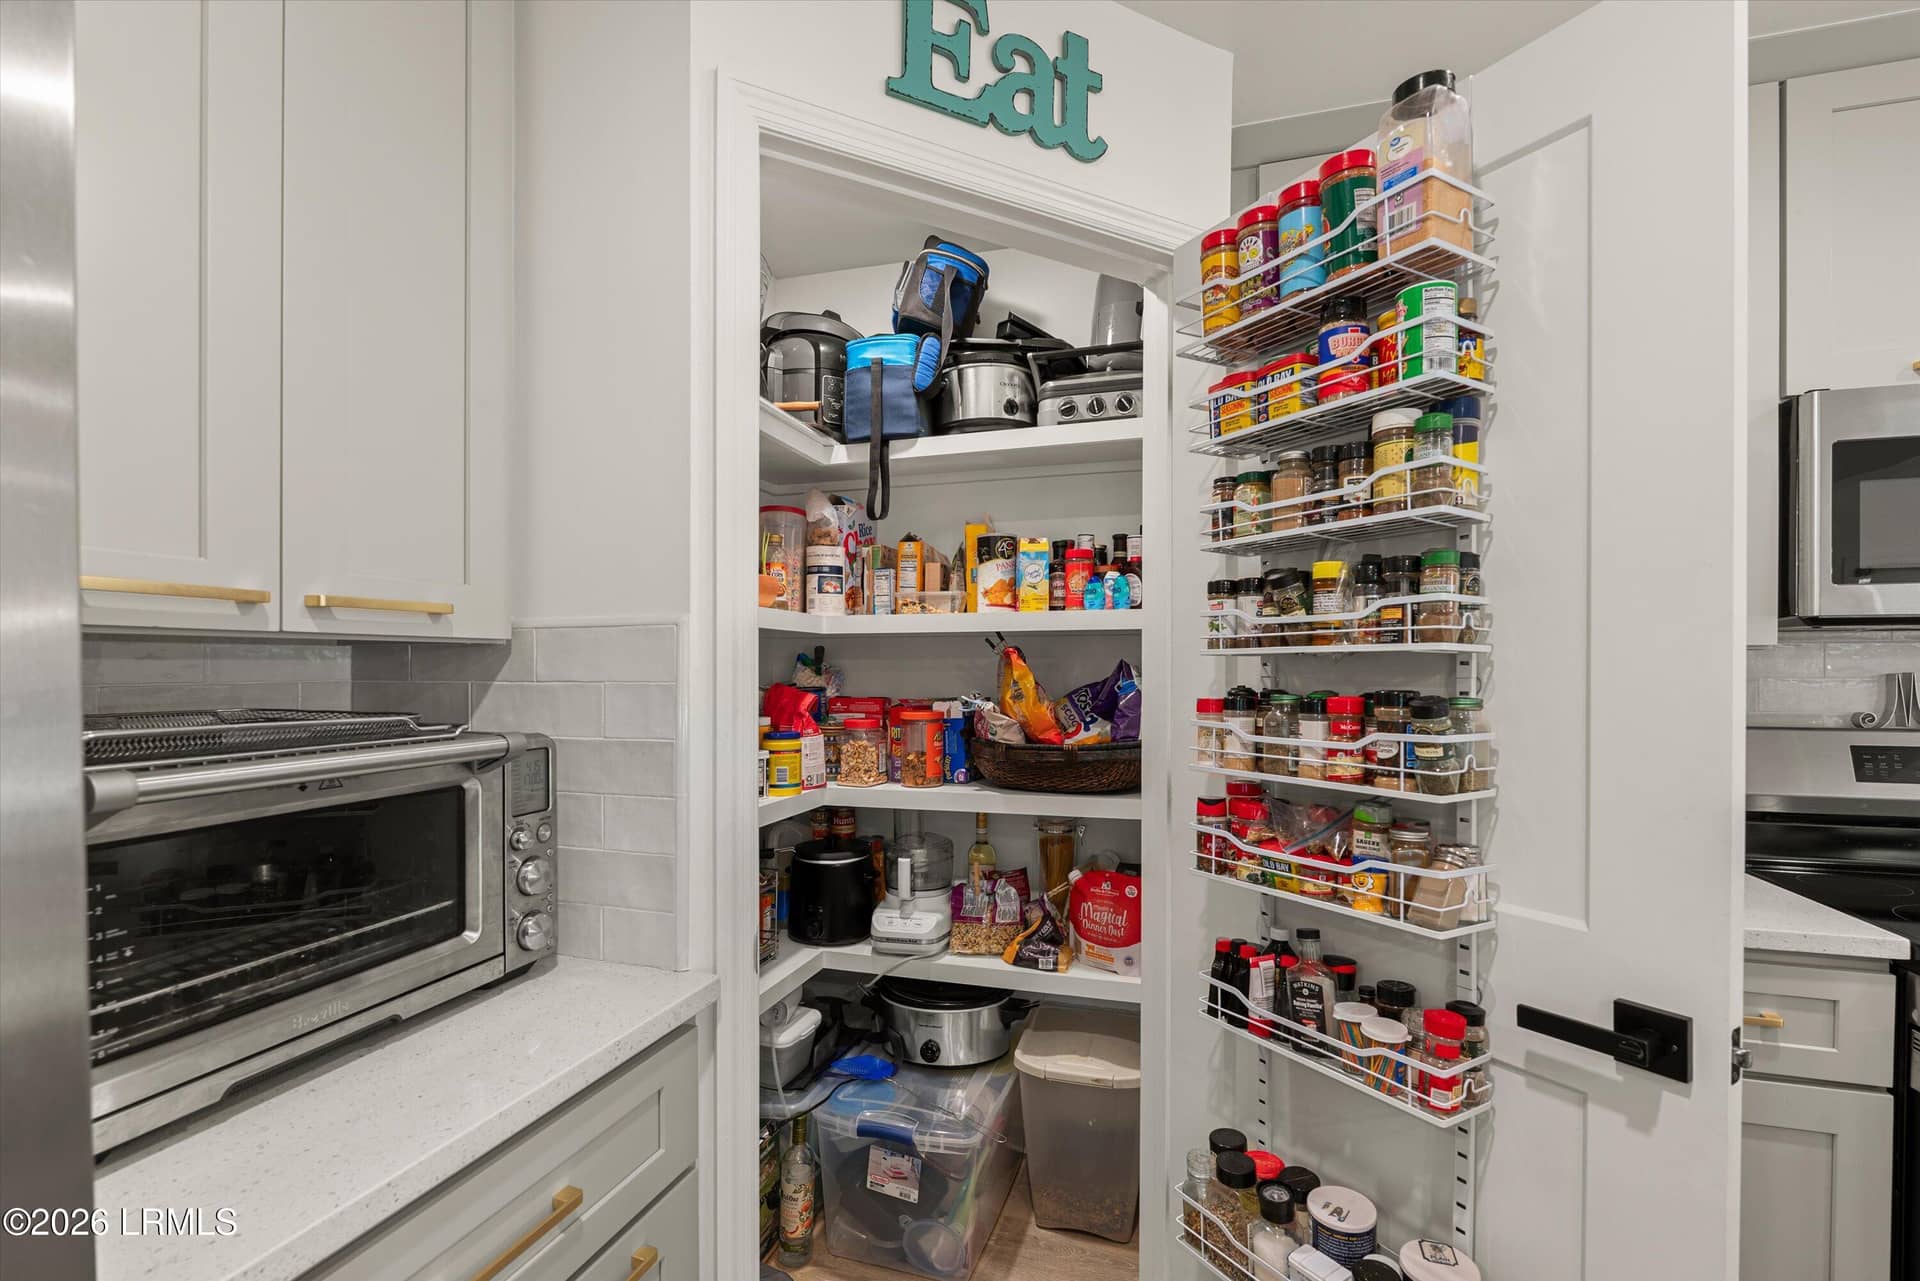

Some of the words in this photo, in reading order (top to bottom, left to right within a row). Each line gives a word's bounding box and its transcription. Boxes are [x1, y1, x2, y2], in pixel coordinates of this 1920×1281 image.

[886, 0, 1108, 163] Eat
[858, 523, 873, 538] Rice
[999, 540, 1015, 558] 4C
[1276, 861, 1290, 872] BAY
[1080, 901, 1129, 927] Magical
[1082, 919, 1107, 935] Dinner
[1108, 925, 1125, 937] Dust
